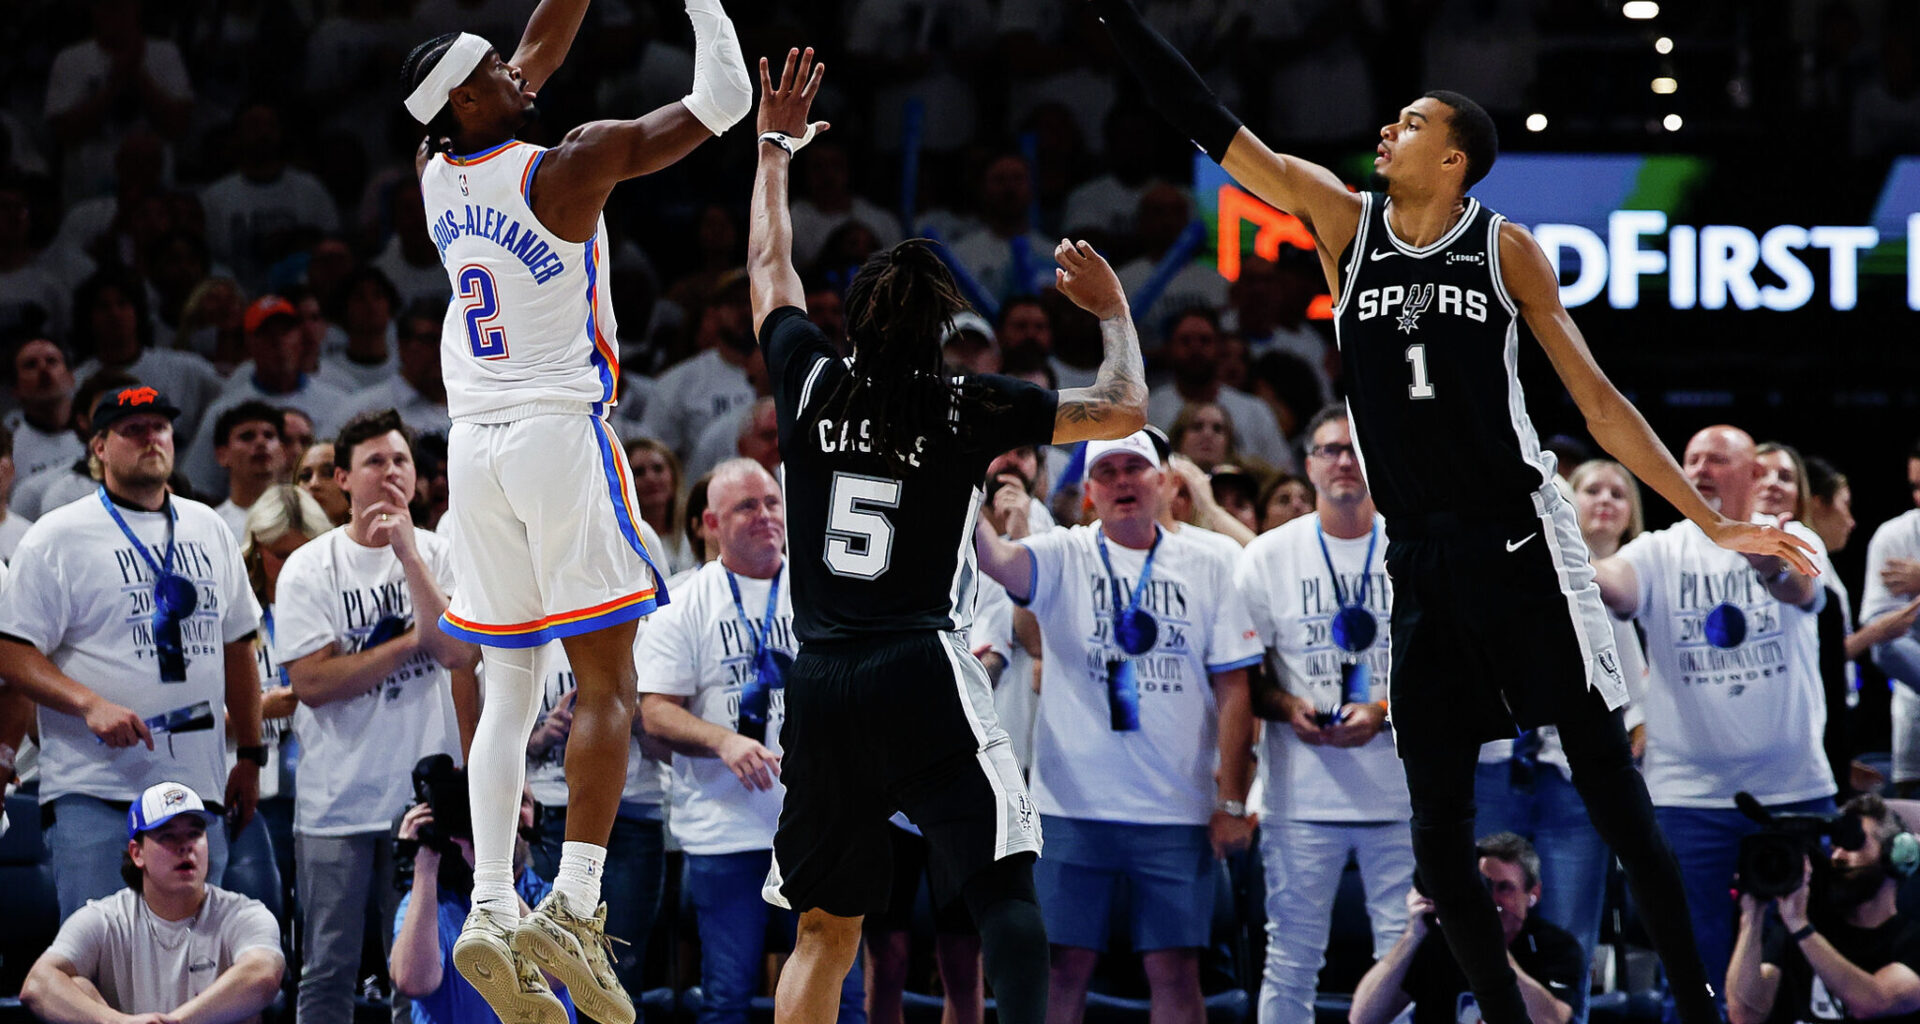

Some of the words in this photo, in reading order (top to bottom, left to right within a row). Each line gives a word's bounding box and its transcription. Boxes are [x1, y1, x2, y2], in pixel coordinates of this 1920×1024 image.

[433, 204, 565, 286] OUS-ALEXANDER
[1449, 253, 1481, 263] LEDGER
[1517, 209, 1880, 312] DFIRST
[457, 263, 510, 360] 2
[1358, 283, 1488, 334] SPURS
[1405, 343, 1435, 400] 1
[822, 470, 903, 581] 5
[130, 591, 150, 615] 20
[203, 587, 218, 610] 26
[1165, 624, 1186, 648] 26
[1305, 623, 1327, 646] 20
